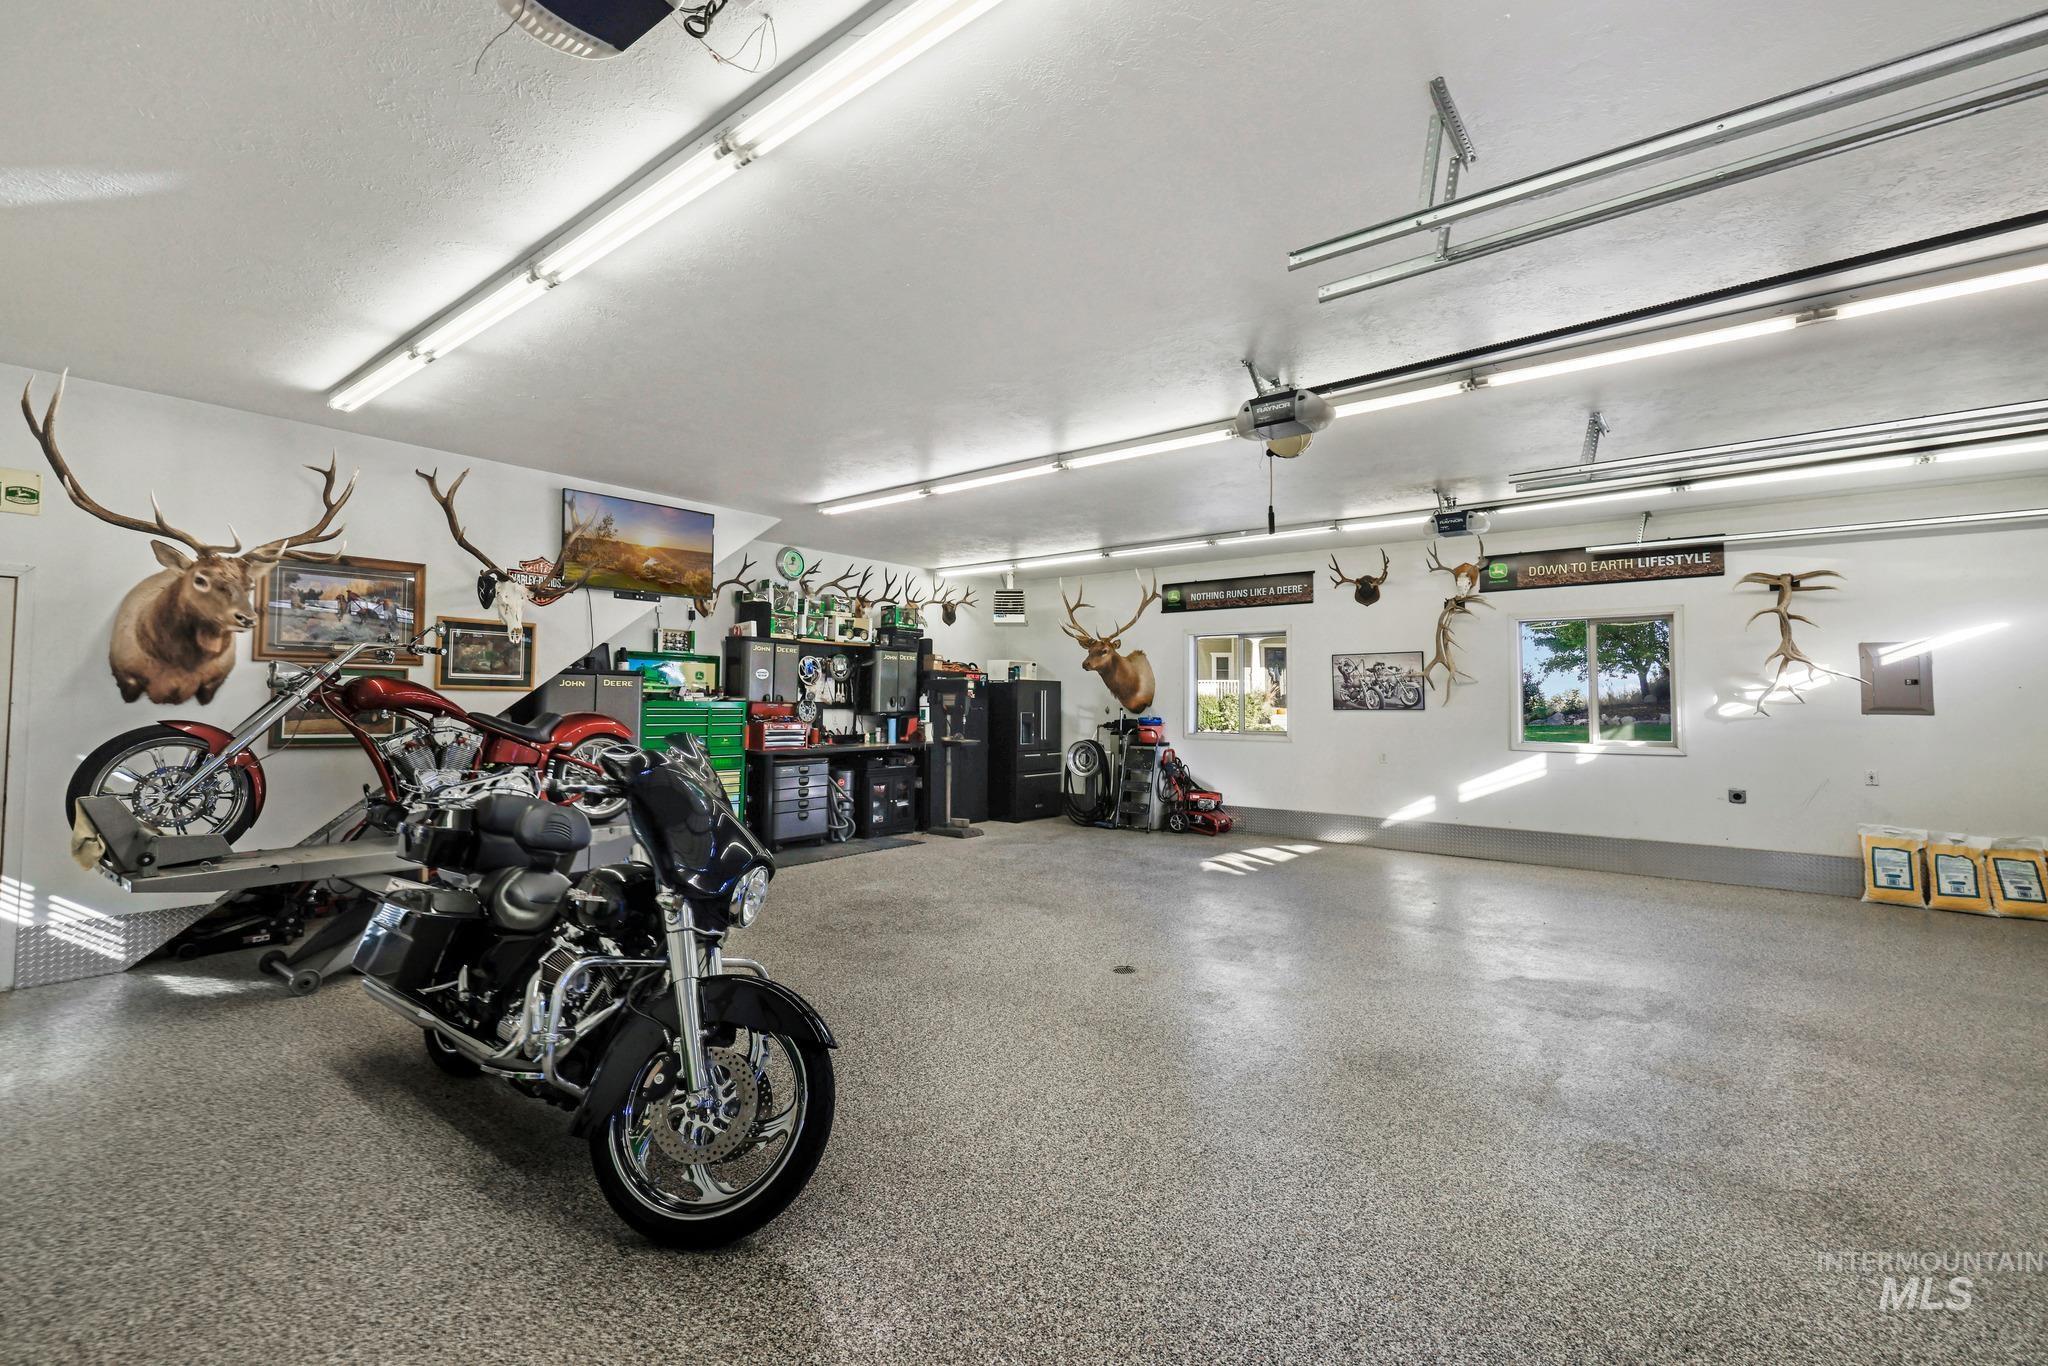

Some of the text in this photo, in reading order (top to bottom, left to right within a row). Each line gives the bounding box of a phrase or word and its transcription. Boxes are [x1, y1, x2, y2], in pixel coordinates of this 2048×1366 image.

[1256, 402, 1291, 413] RAYNOR
[1528, 552, 1711, 577] DOWN TO EARTH LIFESTYLE
[1190, 590, 1225, 601] NOTHING
[1226, 589, 1248, 599] RUNS
[1250, 587, 1267, 597] LIKE
[1269, 586, 1275, 595] A
[559, 679, 633, 687] JOHN DEERE
